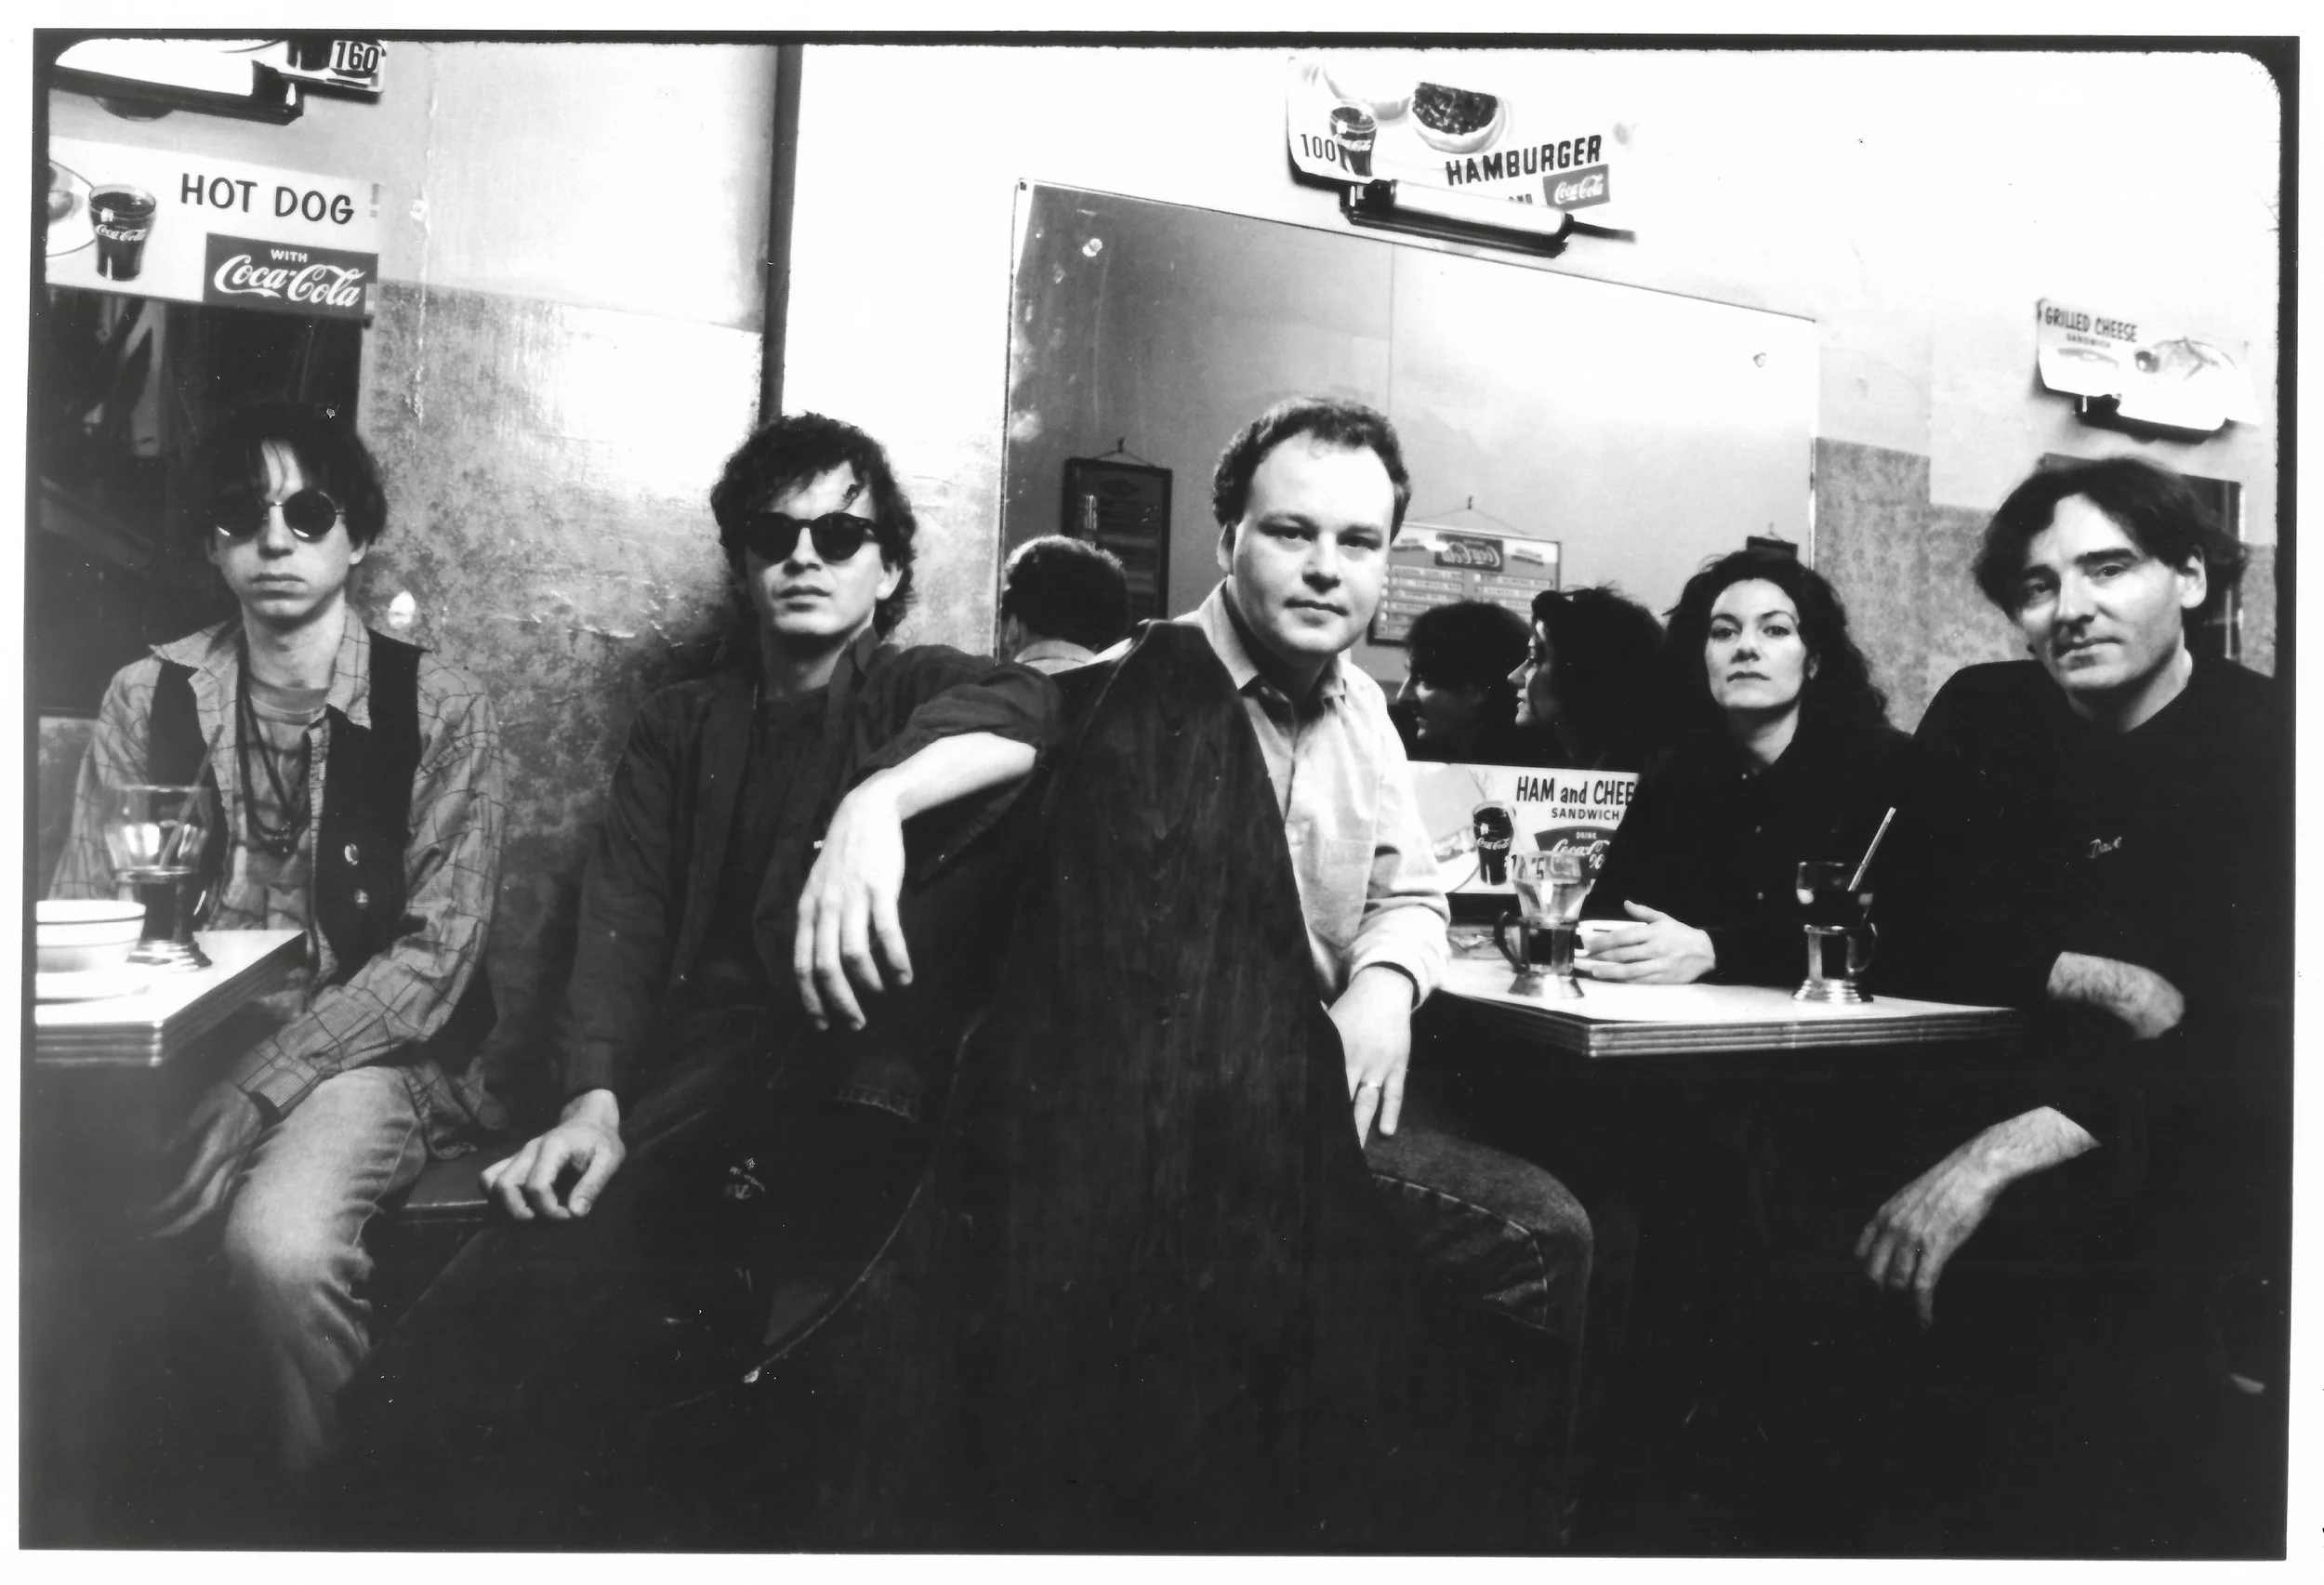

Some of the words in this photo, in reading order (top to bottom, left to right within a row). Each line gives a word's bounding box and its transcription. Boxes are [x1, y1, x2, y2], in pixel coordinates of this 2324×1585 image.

[337, 41, 379, 73] 160
[1301, 133, 1336, 162] 100
[1446, 134, 1602, 186] HAMBURGER
[181, 173, 258, 213] HOT
[275, 186, 354, 225] DOG
[271, 249, 308, 262] WITH
[214, 254, 366, 307] Coca-Cola
[2045, 306, 2091, 333] GRILLED
[2094, 317, 2137, 343] CHEESE
[1516, 775, 1554, 802] HAM
[1560, 781, 1588, 804] and
[1552, 807, 1619, 821] SANDWICH
